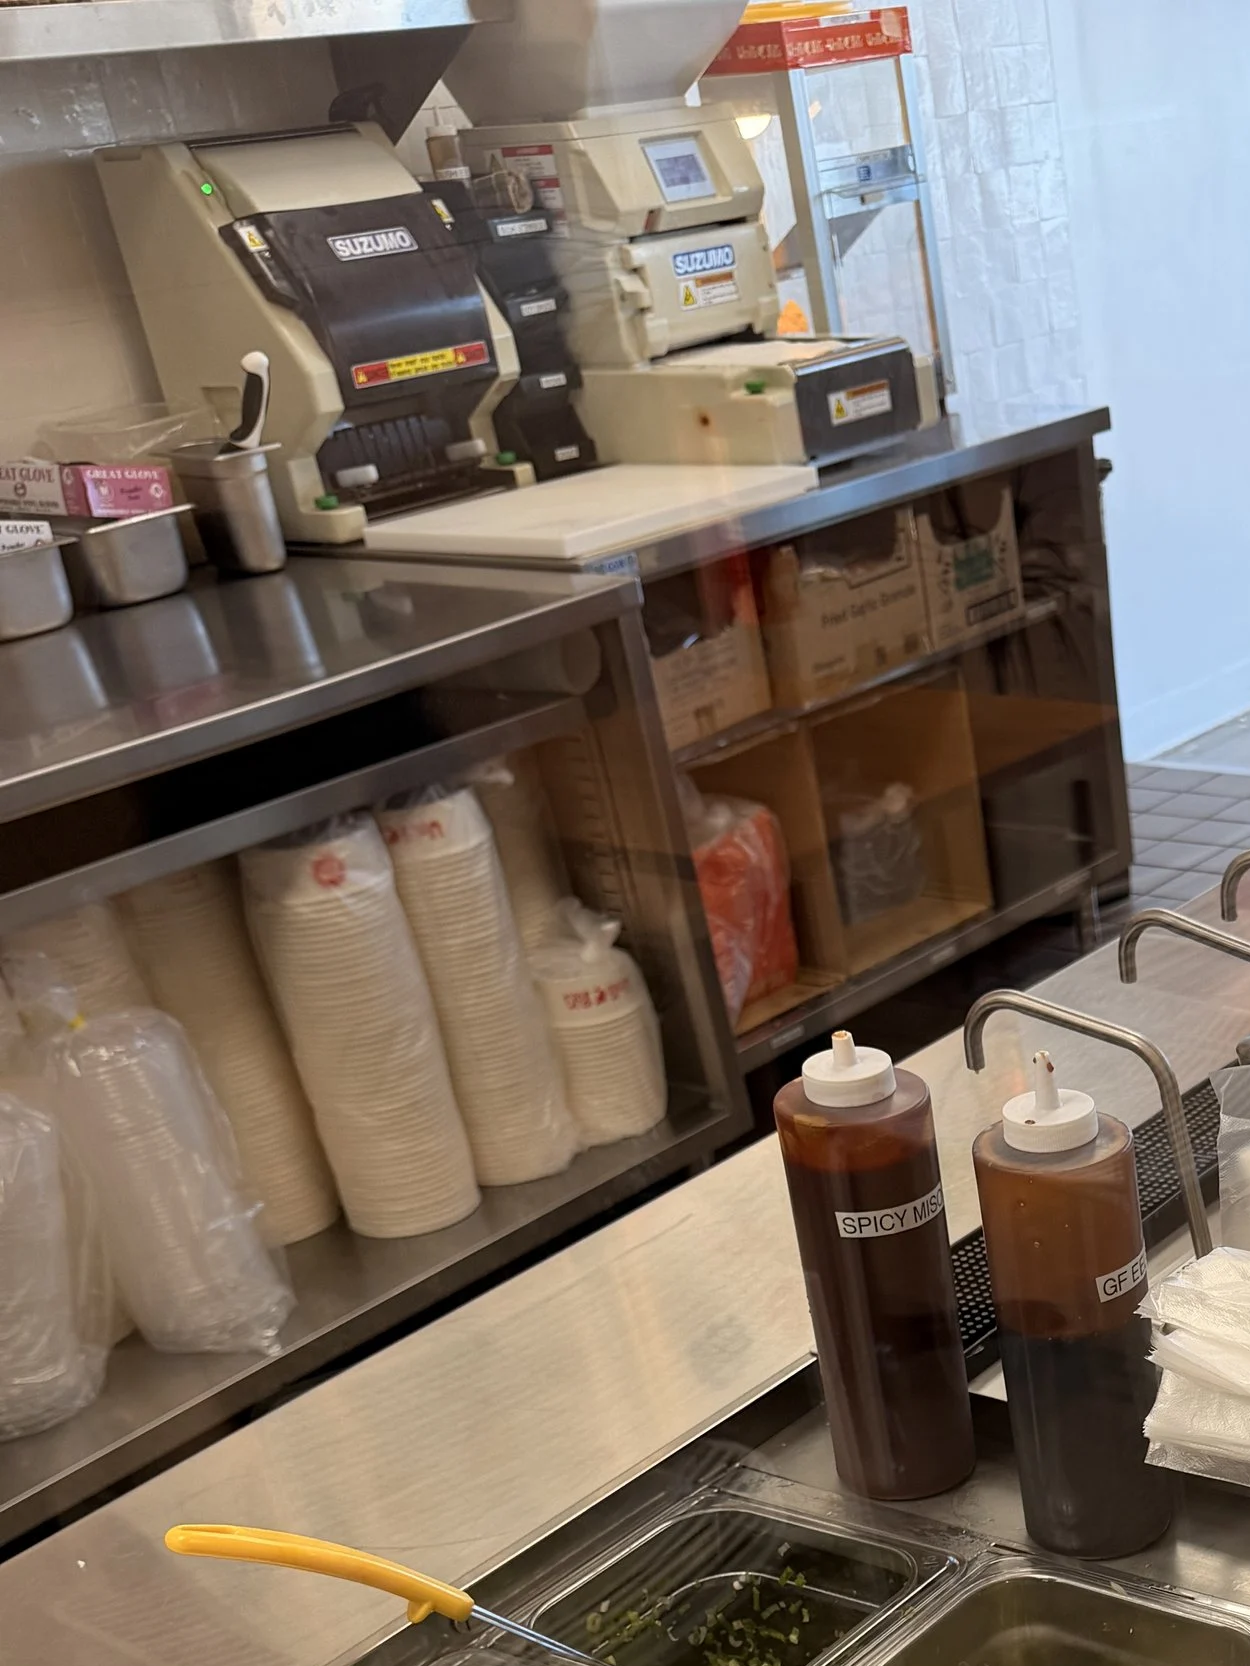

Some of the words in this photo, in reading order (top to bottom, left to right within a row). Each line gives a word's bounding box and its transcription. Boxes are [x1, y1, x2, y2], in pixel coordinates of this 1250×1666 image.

[334, 231, 412, 258] SUZUMO
[674, 247, 735, 275] SUZUMO
[20, 467, 55, 483] GLOVE
[86, 469, 122, 480] GREAT
[124, 469, 159, 480] GLOVE
[5, 524, 45, 535] GLOVE
[842, 1208, 908, 1235] SPICY
[1103, 1270, 1128, 1296] GF
